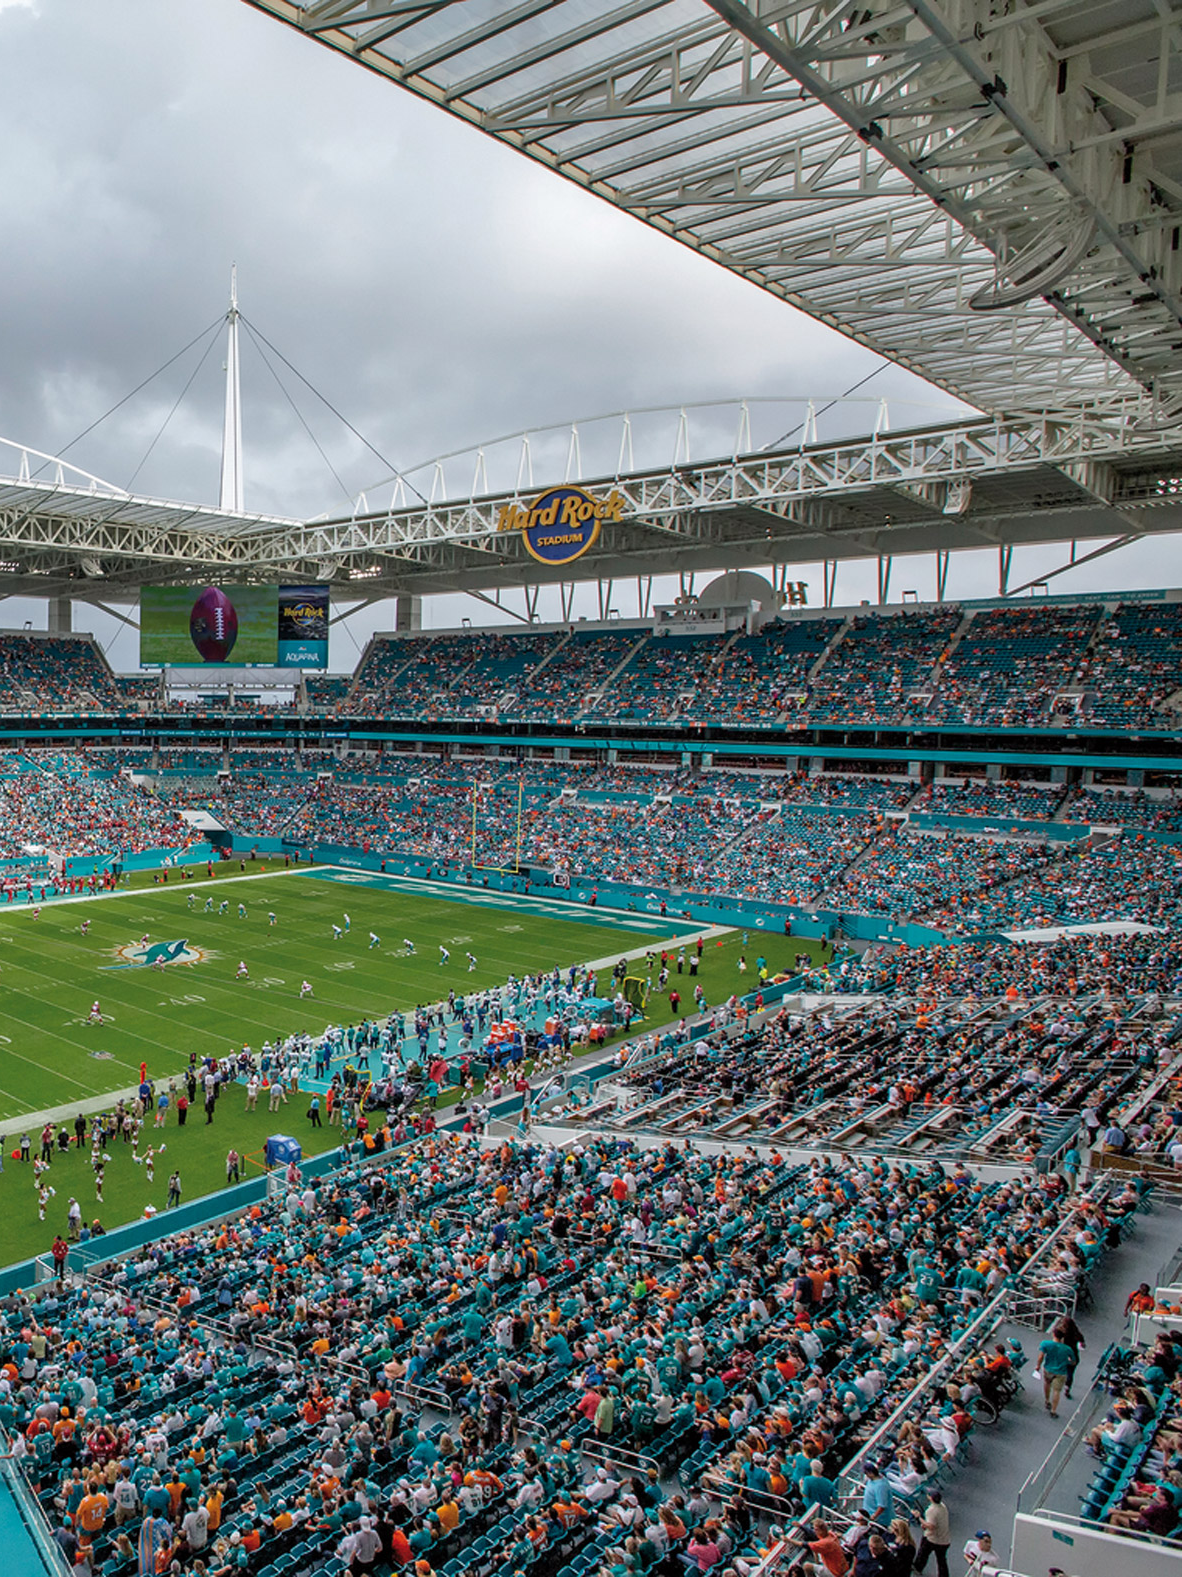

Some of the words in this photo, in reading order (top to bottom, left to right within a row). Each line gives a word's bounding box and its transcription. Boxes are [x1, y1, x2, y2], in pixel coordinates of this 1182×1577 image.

[497, 498, 560, 531] Hard
[560, 490, 626, 529] Rock
[537, 533, 583, 547] STADIUM
[285, 652, 319, 662] AQUAFINA
[919, 1273, 934, 1286] 23
[665, 1366, 678, 1377] 93
[91, 1508, 103, 1521] 14
